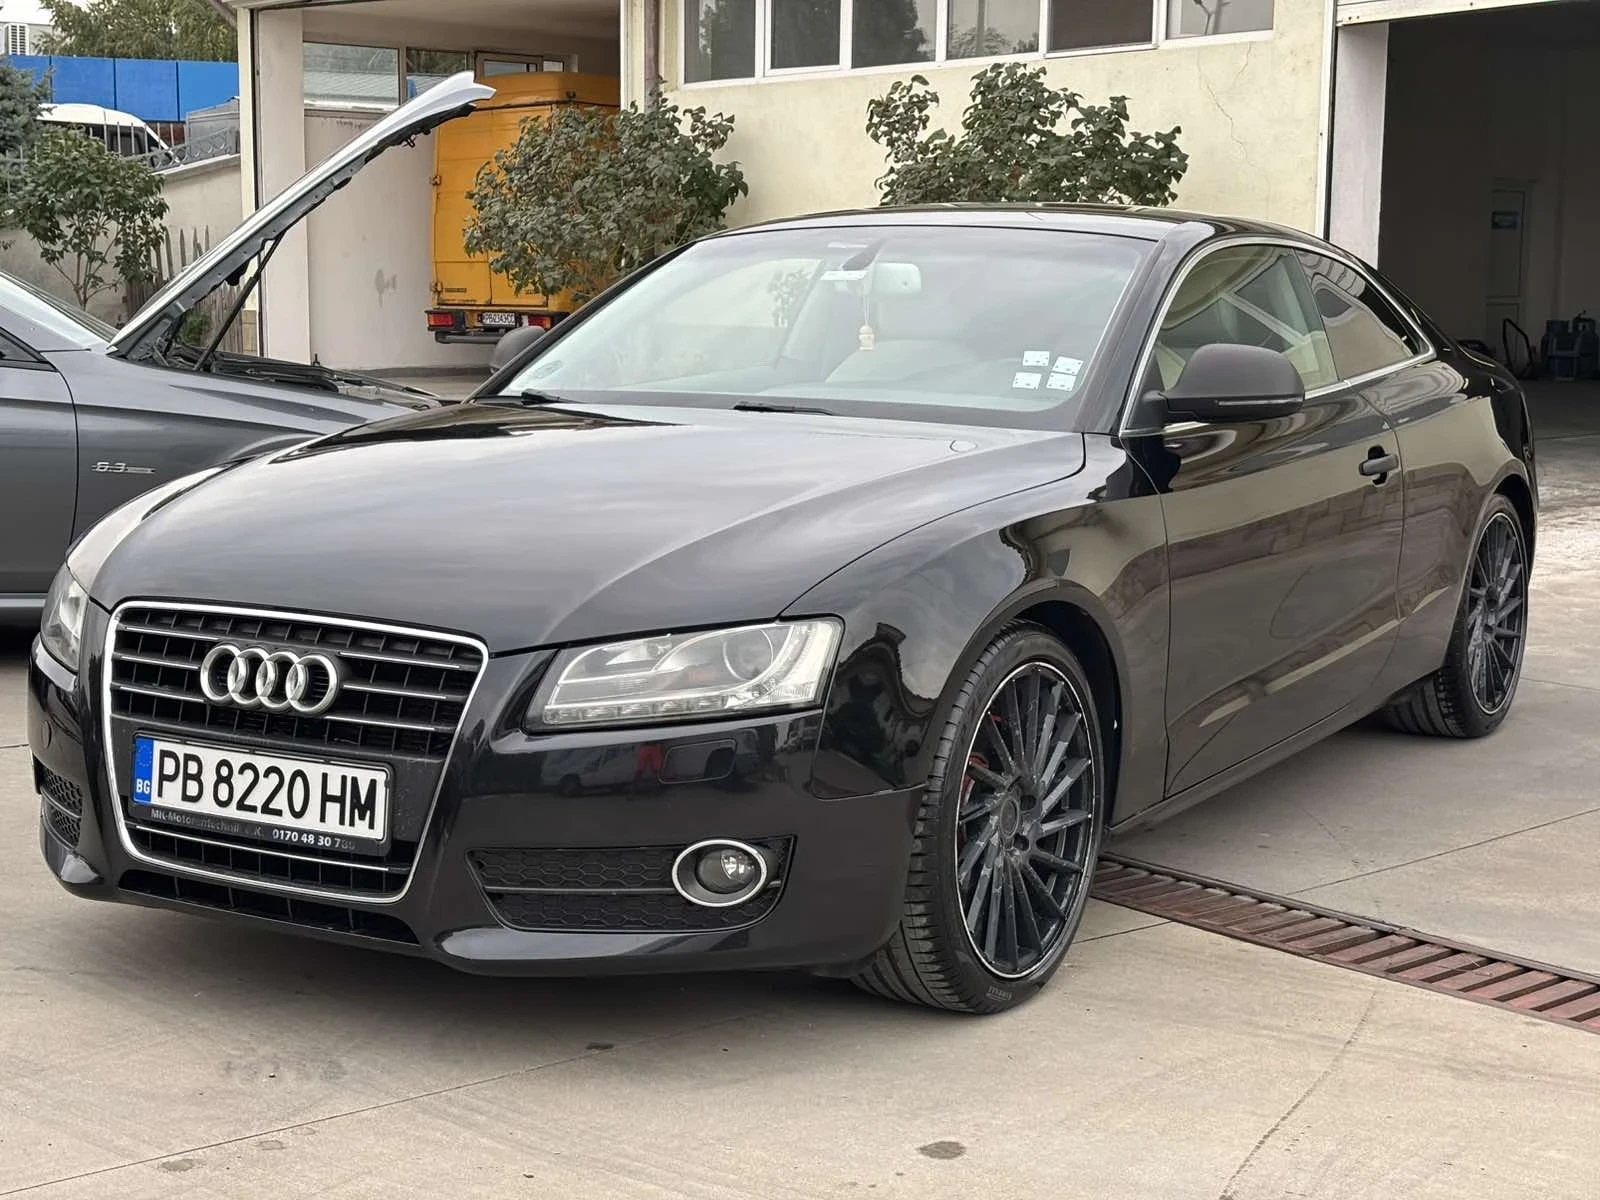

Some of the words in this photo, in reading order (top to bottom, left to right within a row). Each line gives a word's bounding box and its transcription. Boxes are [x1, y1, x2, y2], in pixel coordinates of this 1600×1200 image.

[135, 779, 150, 794] BG
[157, 749, 204, 803] PB
[212, 758, 310, 819] 8220
[319, 771, 378, 830] HM
[272, 828, 299, 842] 0170
[300, 833, 315, 845] 48
[317, 836, 332, 847] 30
